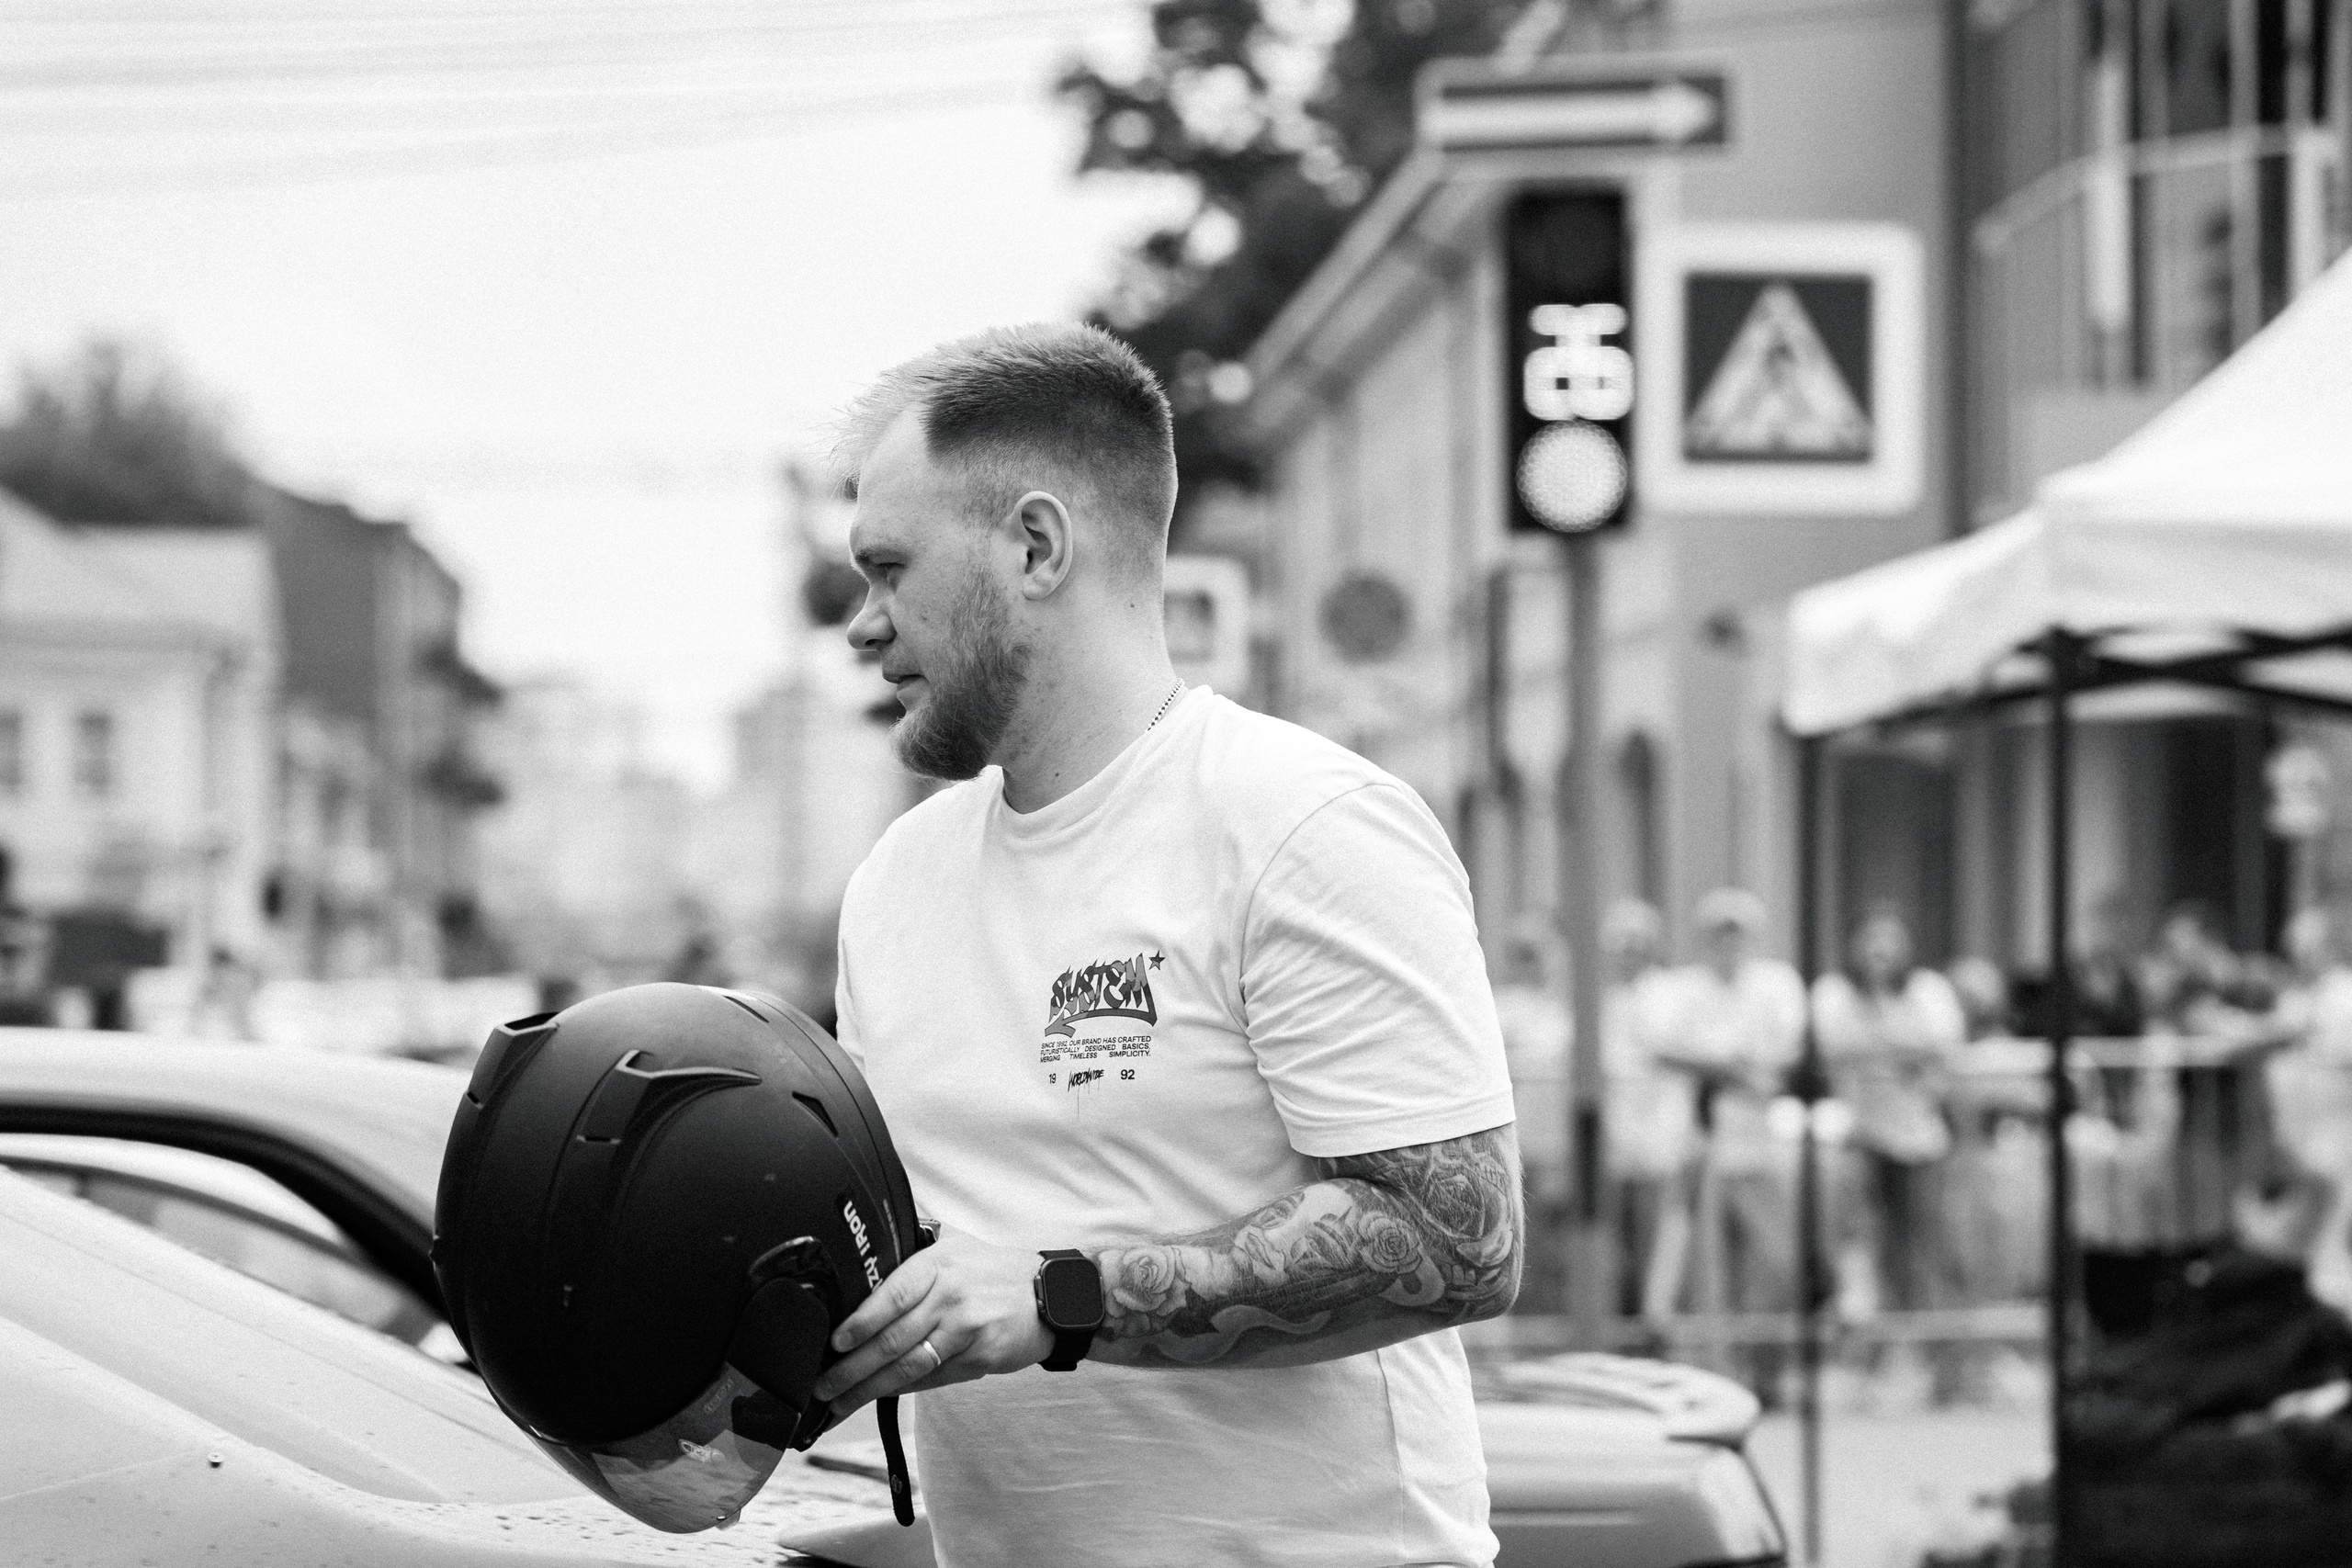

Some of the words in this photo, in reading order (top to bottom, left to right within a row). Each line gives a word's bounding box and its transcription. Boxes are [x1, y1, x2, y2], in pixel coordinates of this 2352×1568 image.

[1084, 1043, 1116, 1052] DESIGNED
[1040, 1055, 1060, 1063] MERGING
[1048, 1073, 1057, 1084] 19
[1120, 1069, 1136, 1080] 92
